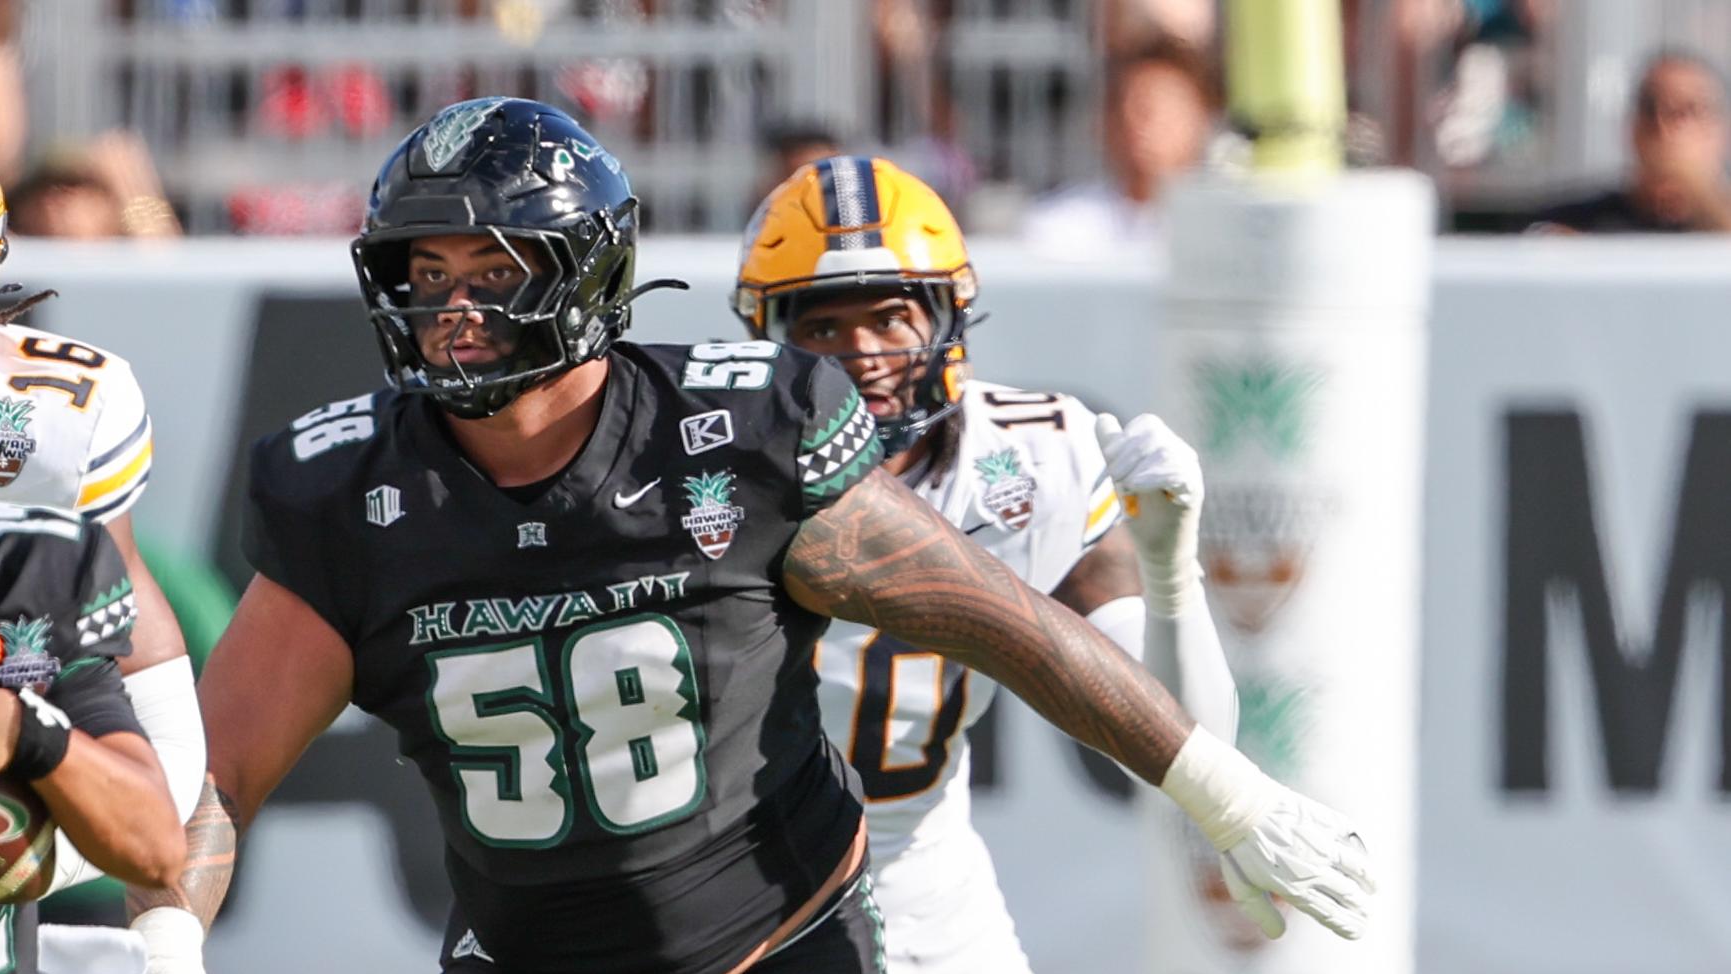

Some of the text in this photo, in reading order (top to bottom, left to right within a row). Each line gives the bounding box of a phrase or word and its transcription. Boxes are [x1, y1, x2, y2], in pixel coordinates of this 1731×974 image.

[8, 335, 108, 412] 16
[680, 339, 782, 390] 58
[290, 392, 377, 461] 58
[423, 611, 706, 850] 58
